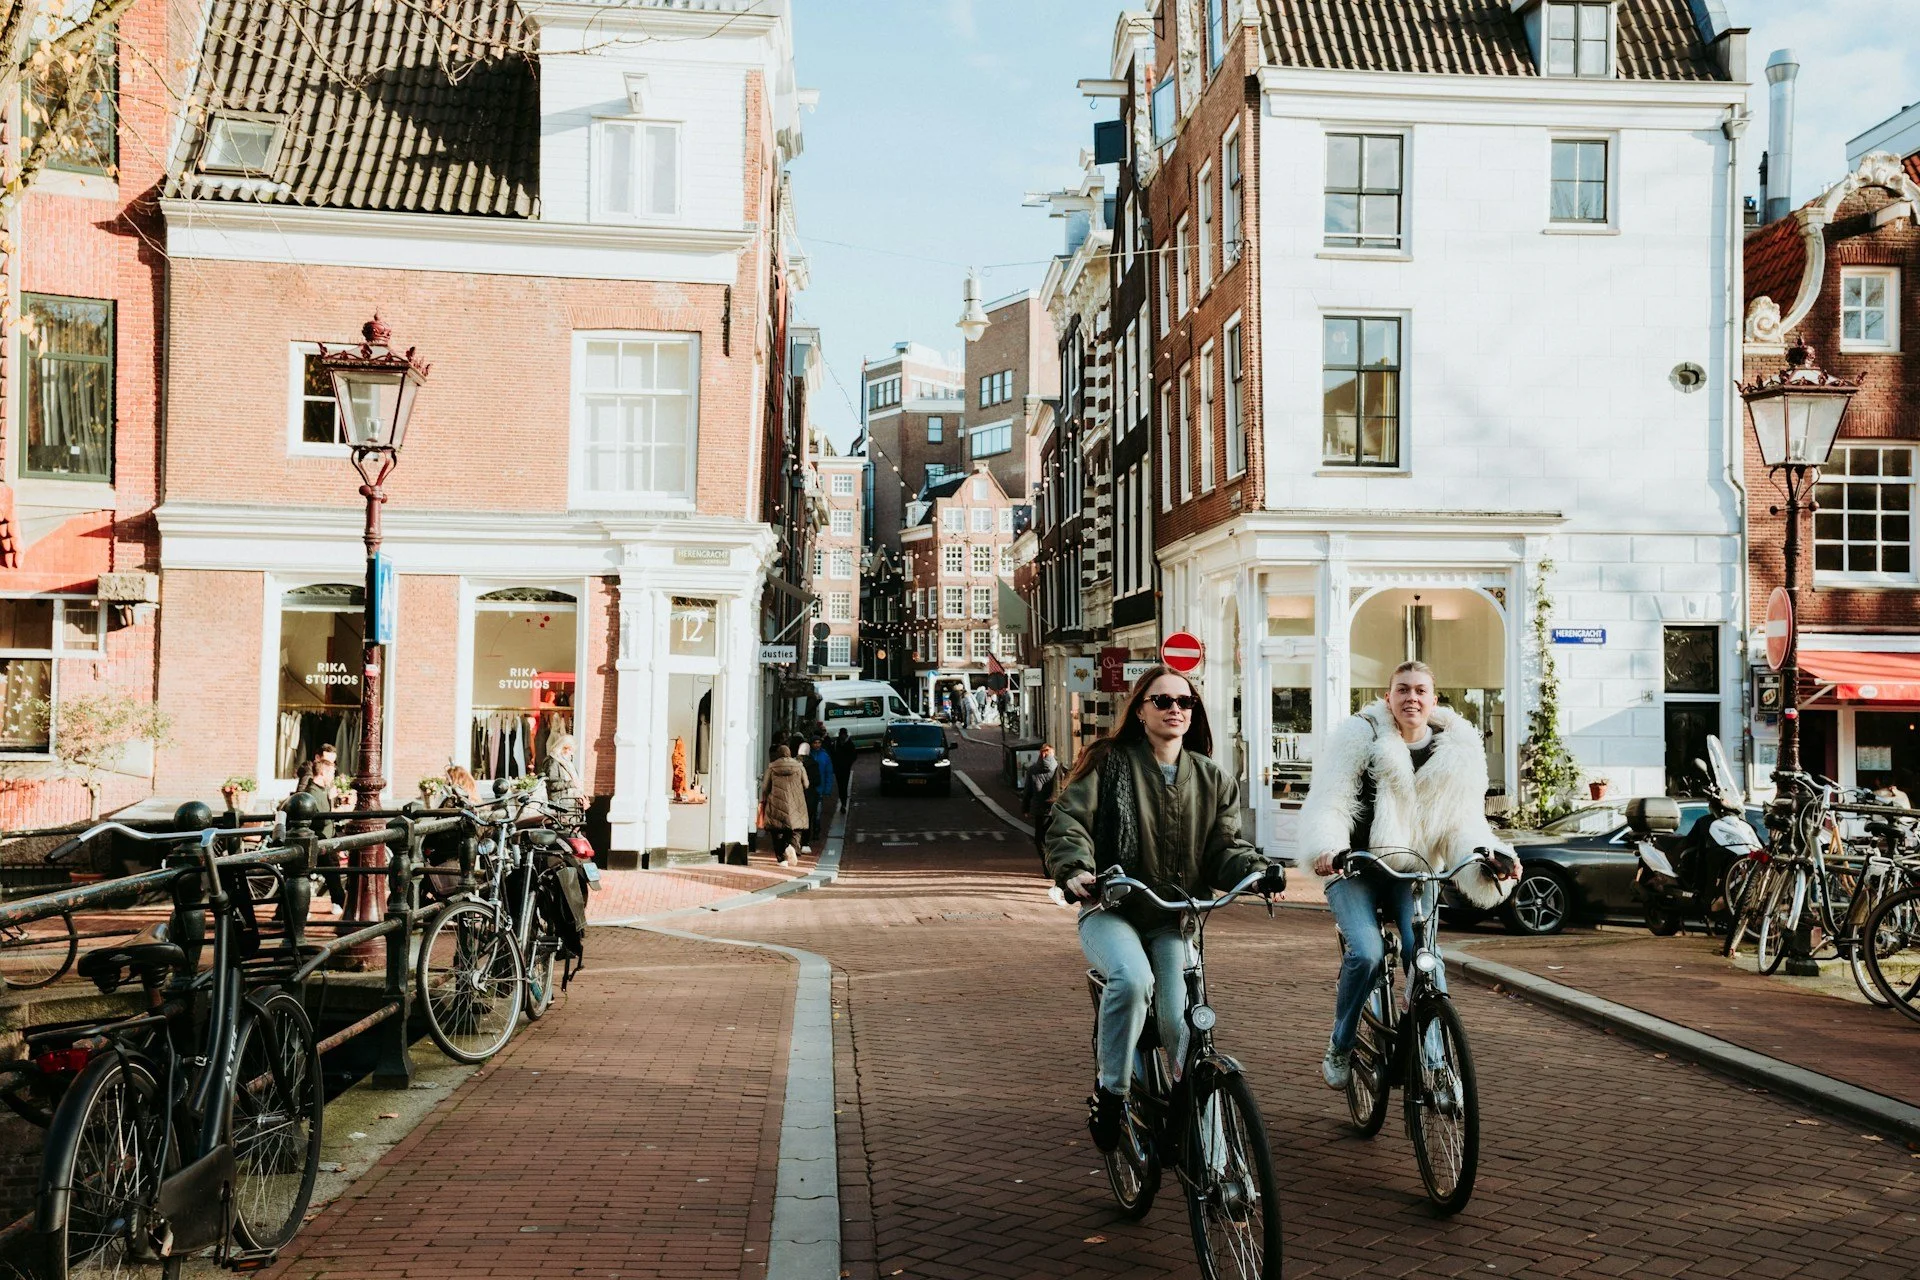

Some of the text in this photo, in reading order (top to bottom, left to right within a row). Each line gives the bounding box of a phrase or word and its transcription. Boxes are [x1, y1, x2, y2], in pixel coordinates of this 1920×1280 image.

[678, 549, 729, 558] HERENGRACHT
[681, 613, 704, 641] 12
[1555, 629, 1602, 638] HERENGRACHT
[762, 650, 793, 658] dusties
[317, 662, 347, 673] RIKA
[510, 667, 539, 677] RIKA
[305, 674, 359, 685] STUDIOS
[499, 679, 550, 689] STUDIOS
